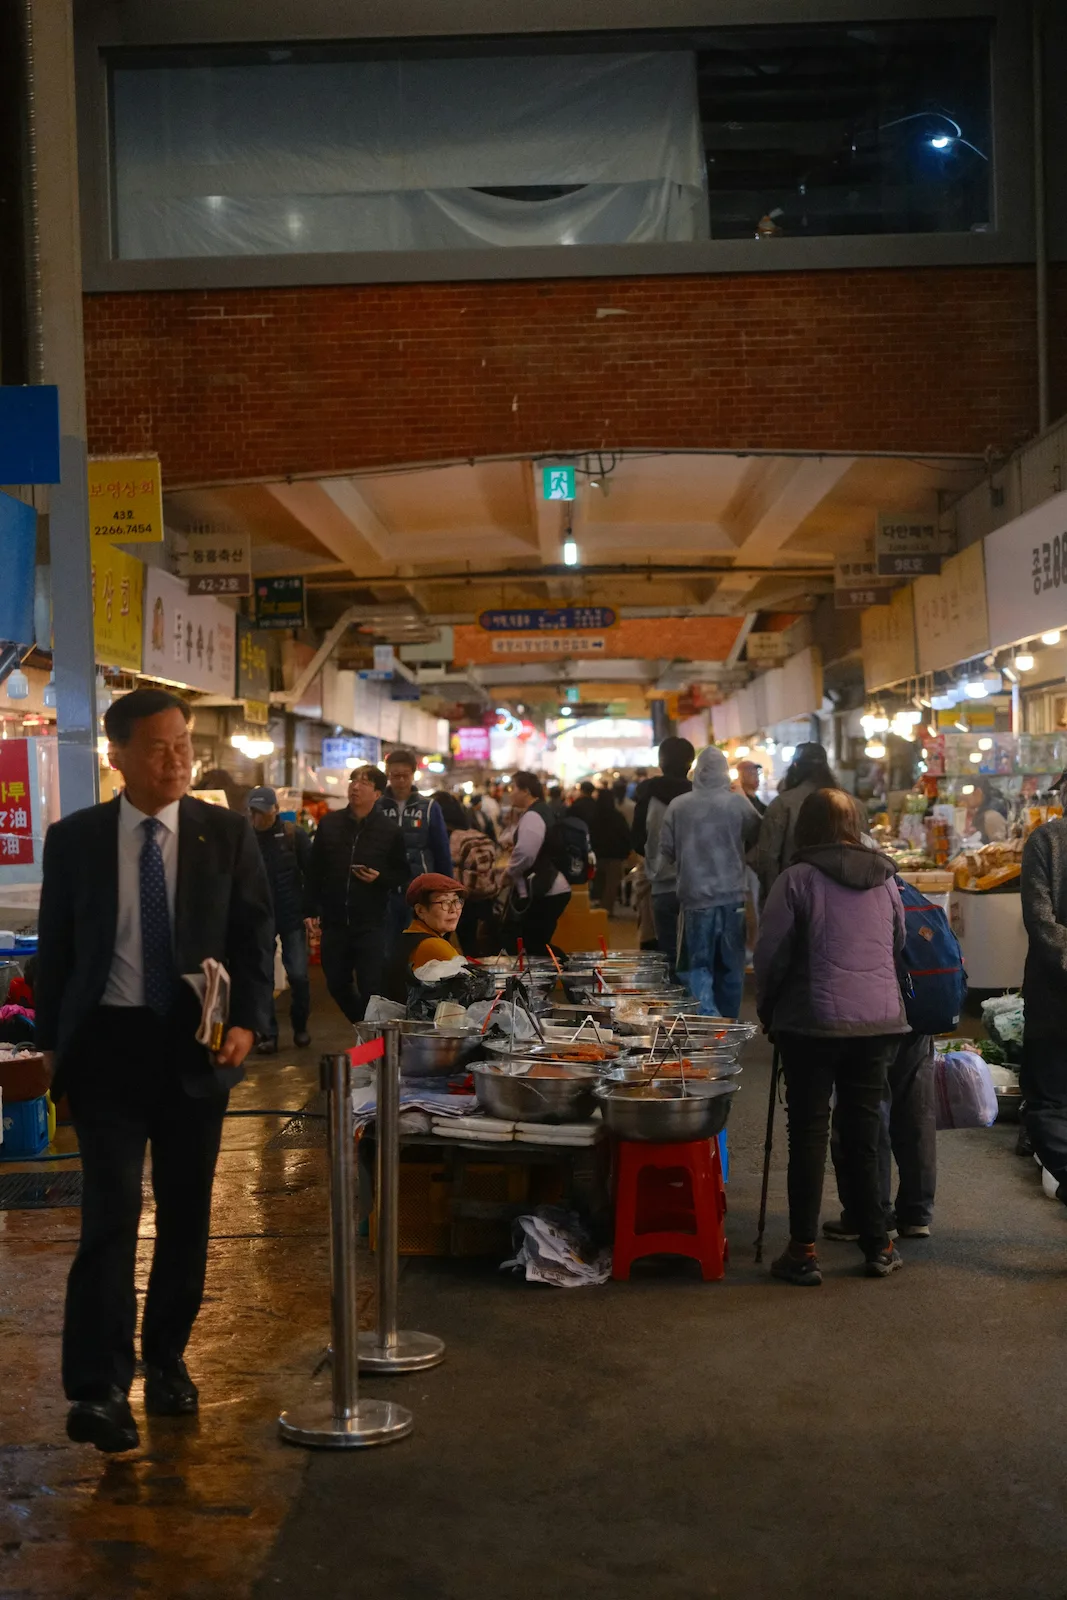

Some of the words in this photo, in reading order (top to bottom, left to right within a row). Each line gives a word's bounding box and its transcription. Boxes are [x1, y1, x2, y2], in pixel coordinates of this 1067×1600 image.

[90, 480, 154, 499] 보영상회
[113, 509, 134, 520] 43호
[94, 523, 152, 536] 2266.7454
[1, 782, 25, 803] 루
